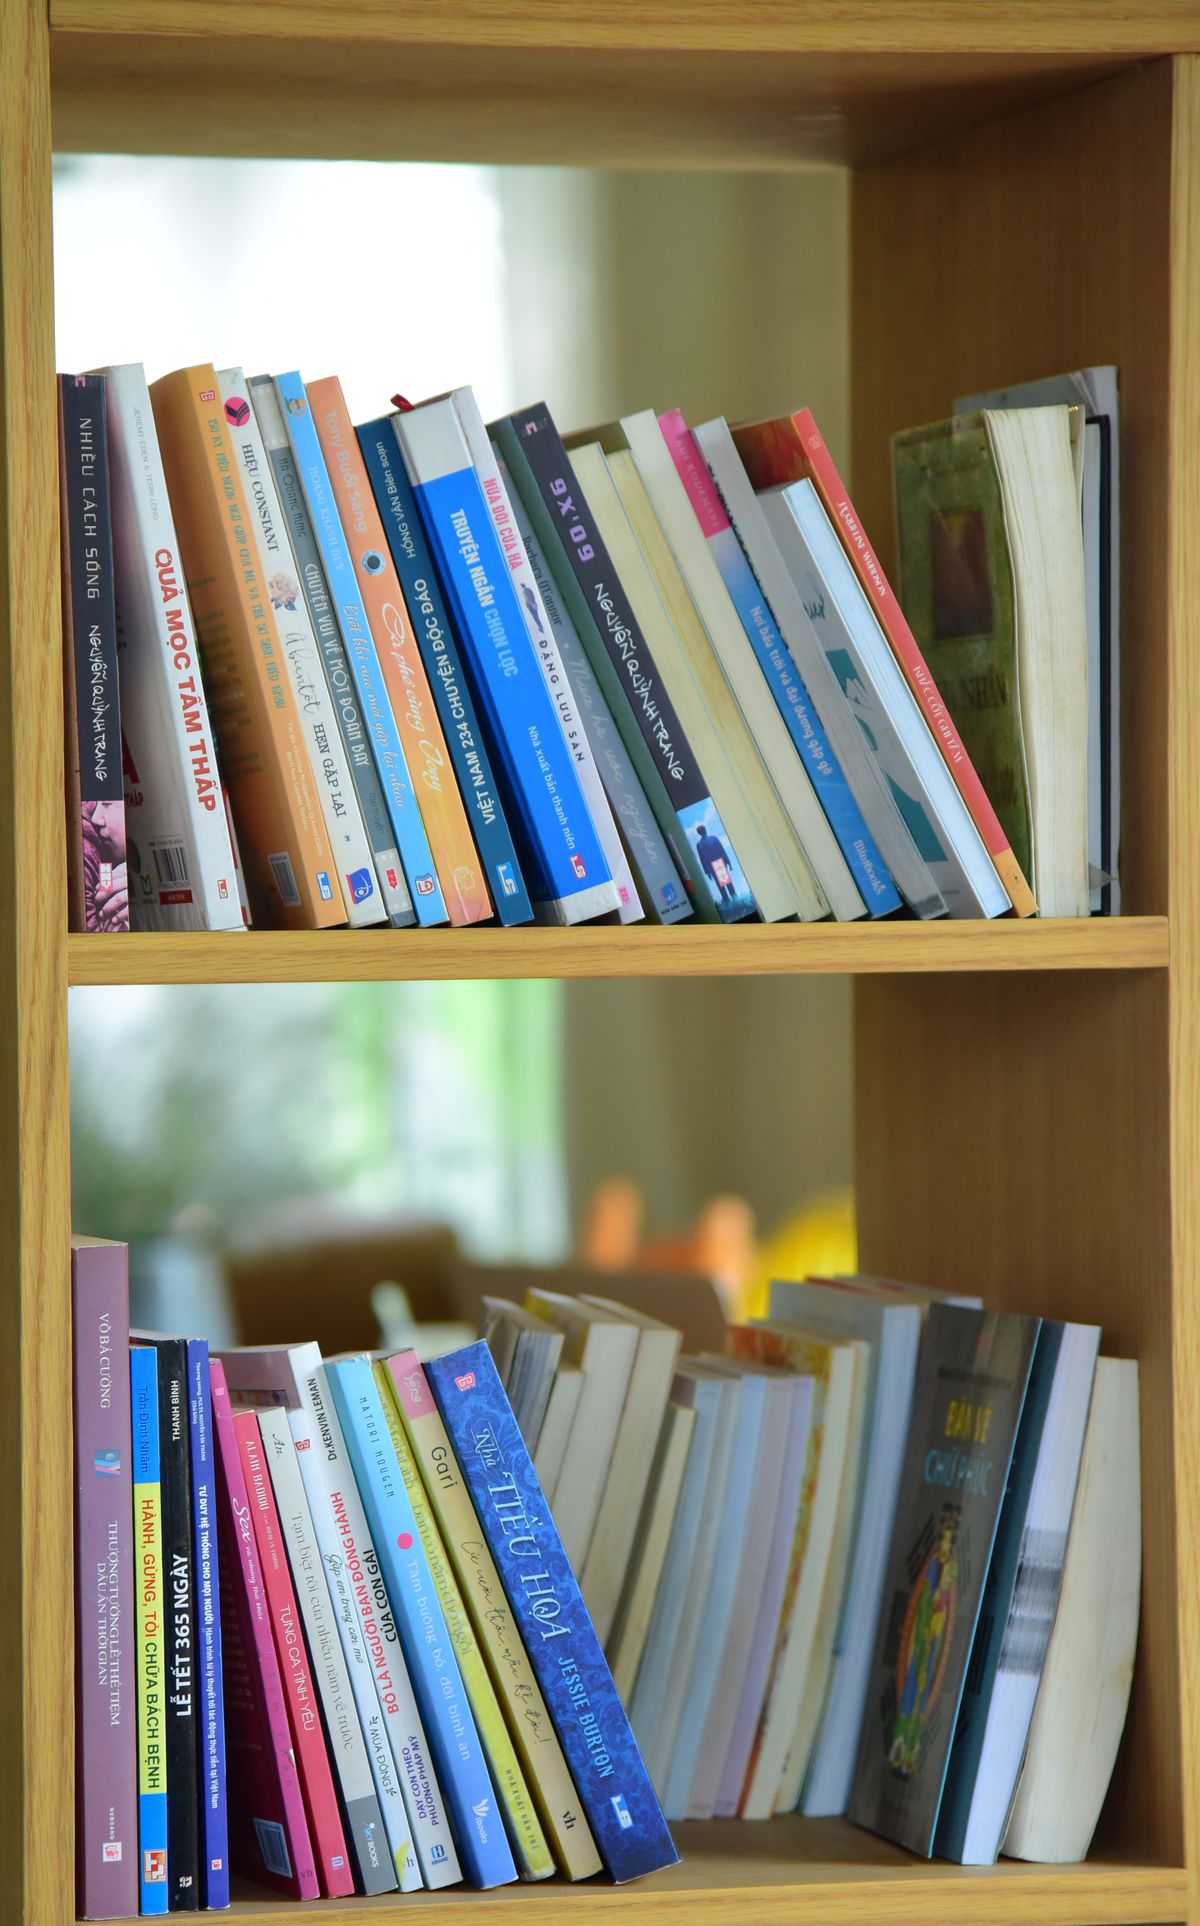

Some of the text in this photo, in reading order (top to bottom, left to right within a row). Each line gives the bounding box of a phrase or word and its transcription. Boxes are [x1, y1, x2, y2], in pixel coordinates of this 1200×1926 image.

[132, 406, 146, 439] JEREMY
[320, 409, 347, 450] Tony
[139, 439, 150, 462] EDEN
[145, 473, 156, 496] TERRY
[82, 487, 99, 536] CÁCH
[149, 497, 160, 520] LONG
[251, 480, 279, 553] CONSTANT
[548, 477, 596, 563] 9X'09
[153, 546, 185, 603] QUẢ
[861, 550, 888, 596] WOODSON
[161, 608, 192, 671] MỌC
[317, 614, 335, 637] VUI
[350, 743, 370, 767] BAY
[351, 633, 372, 662] khi
[389, 771, 410, 809] nhau
[456, 721, 474, 748] 234
[94, 732, 108, 781] TRANG
[567, 730, 585, 762] SAN
[649, 720, 688, 783] TRANG
[465, 749, 486, 787] NAM
[551, 794, 569, 826] thanh
[307, 1377, 325, 1411] LEMAN
[172, 1406, 180, 1441] THANH
[244, 1439, 270, 1511] ALAIN BADIOU
[429, 1444, 459, 1490] Gari
[327, 1490, 353, 1536] HÀNH
[202, 1561, 210, 1578] CHO
[360, 1548, 380, 1576] GÁI
[335, 1579, 347, 1596] em
[370, 1575, 389, 1609] CON
[335, 1596, 355, 1624] trong
[170, 1553, 191, 1715] LỄ TẾT 365 NGÀY
[98, 1651, 108, 1685] GIAN
[287, 1646, 303, 1668] CA
[375, 1669, 394, 1691] LÀ
[145, 1694, 161, 1737] BÁCH
[556, 1653, 615, 1778] JESSIE BURTON
[560, 1809, 578, 1829] vh
